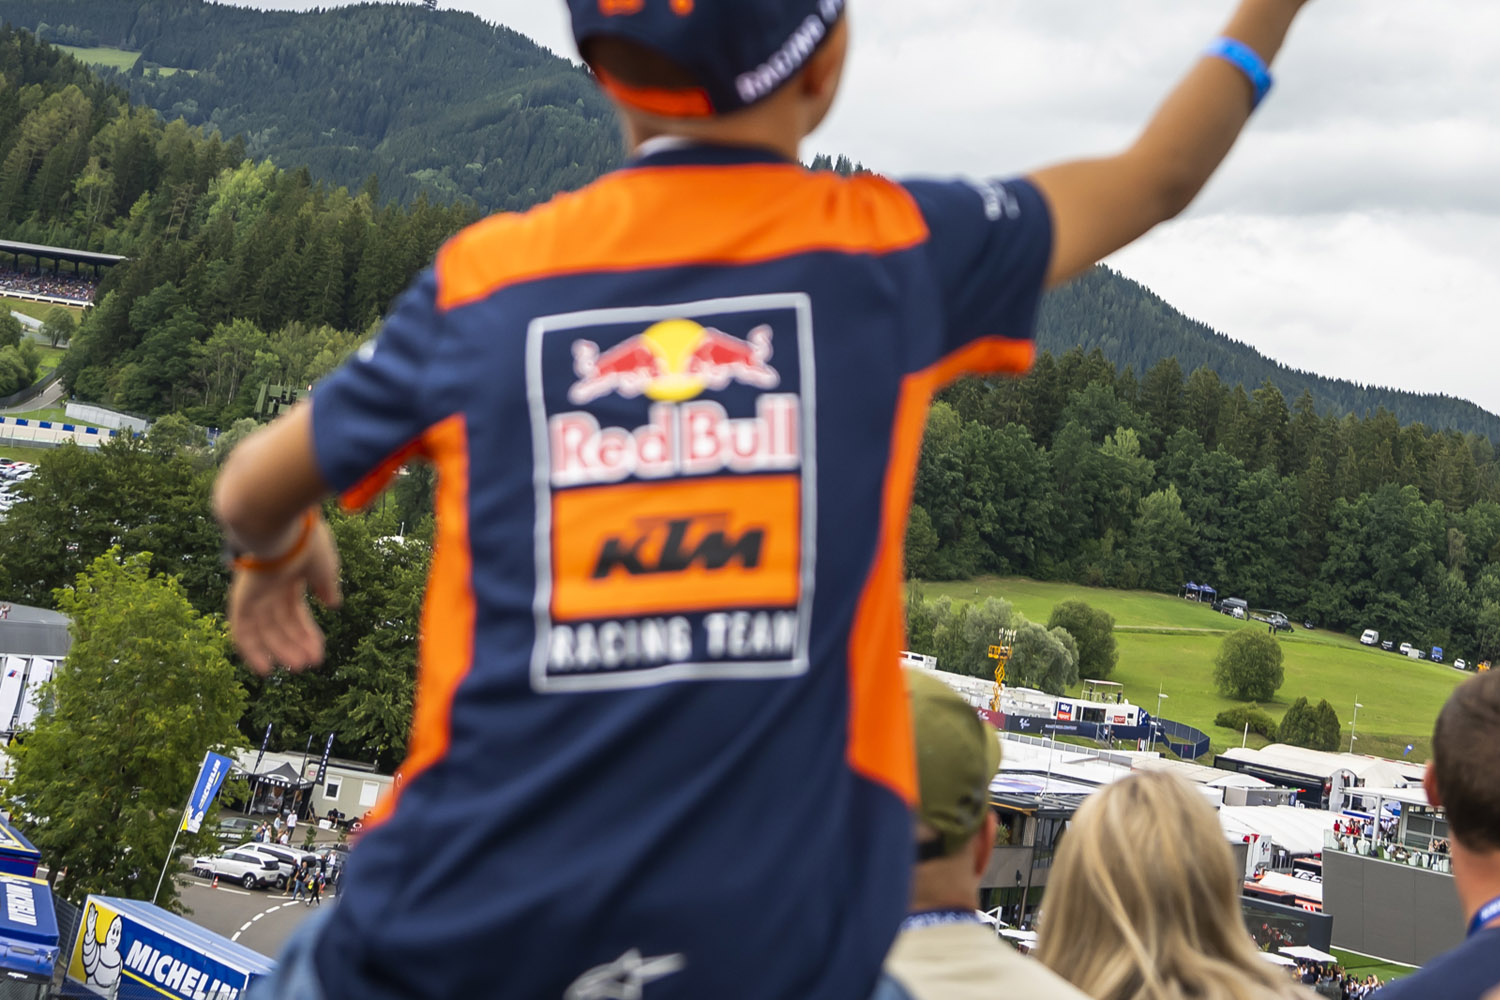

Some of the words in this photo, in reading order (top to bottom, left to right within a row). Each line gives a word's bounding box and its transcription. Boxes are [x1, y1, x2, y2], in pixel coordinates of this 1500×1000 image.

[551, 403, 675, 485] Red
[680, 394, 799, 474] Bull
[592, 517, 765, 579] KTM
[550, 617, 692, 671] RACING
[703, 610, 797, 657] TEAM
[124, 939, 239, 1000] MICHELIN
